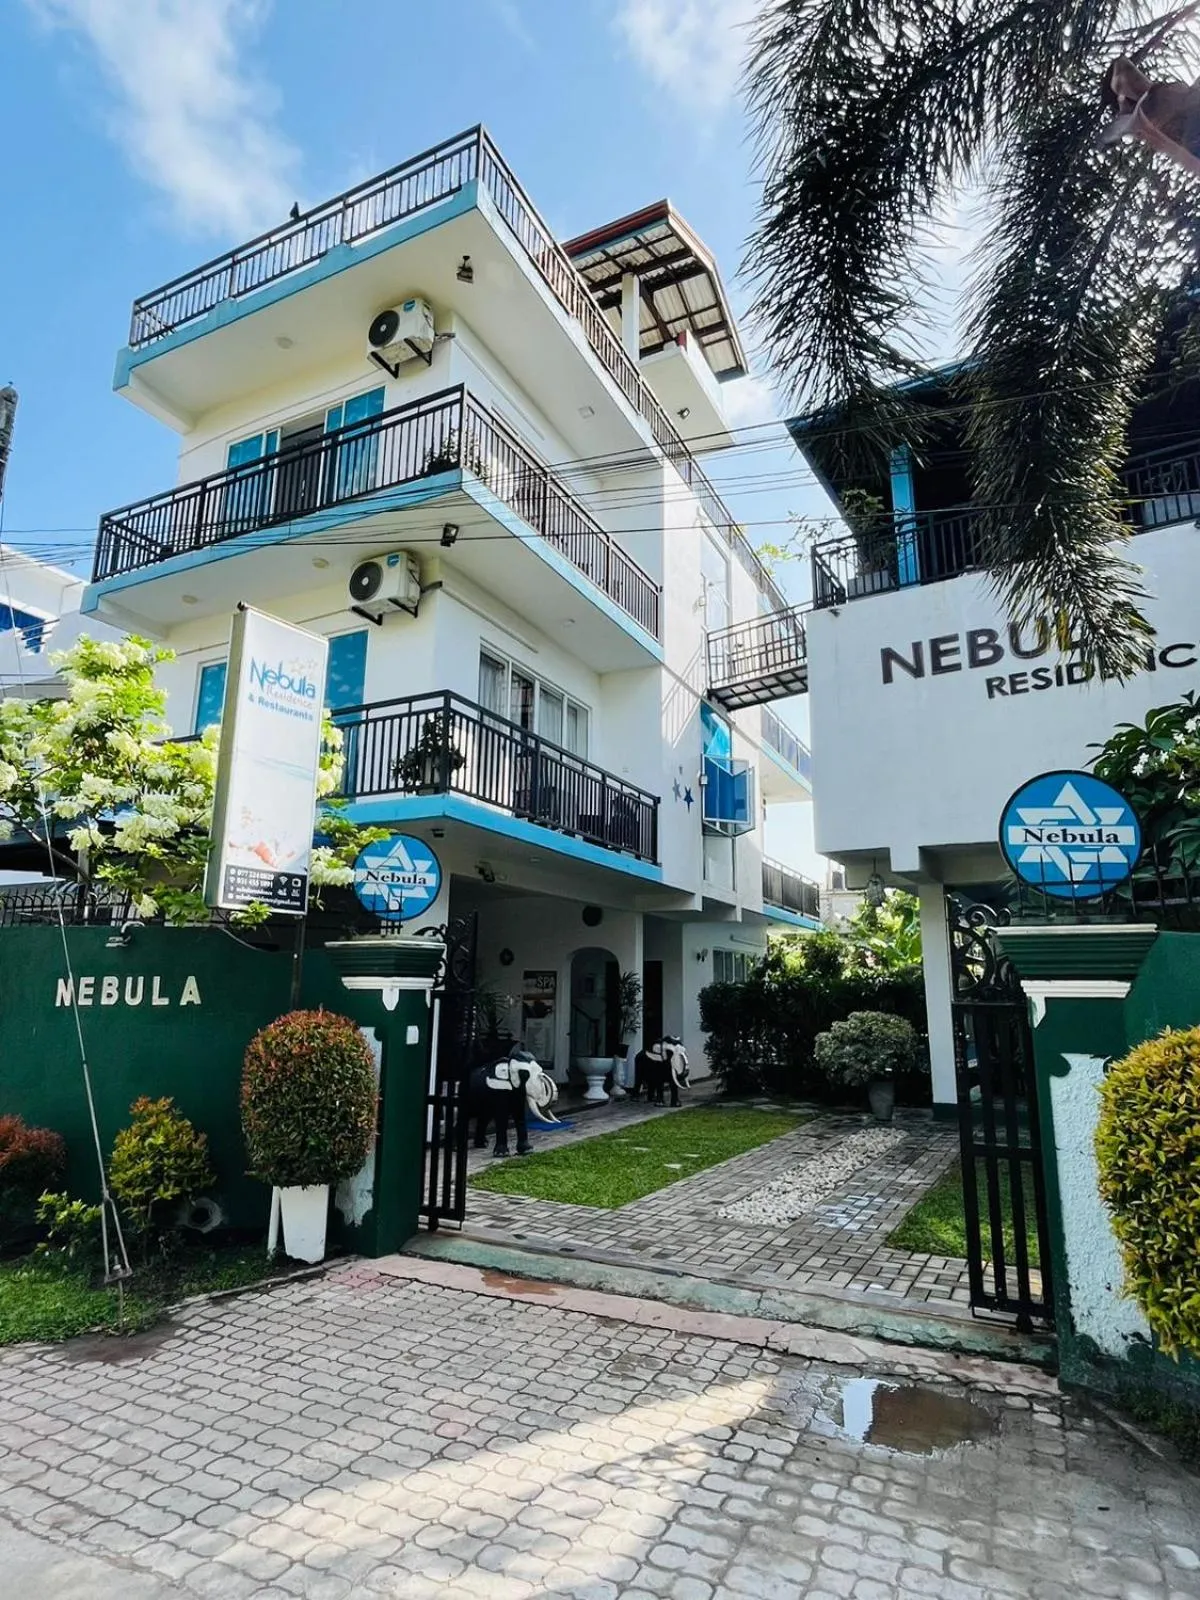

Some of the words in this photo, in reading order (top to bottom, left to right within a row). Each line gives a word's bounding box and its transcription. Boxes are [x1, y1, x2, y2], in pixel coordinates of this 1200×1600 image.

[880, 612, 1104, 685] NEBU
[249, 656, 316, 699] Nebula
[986, 643, 1197, 699] RESIDC
[248, 691, 255, 702] &
[258, 696, 313, 721] Restaurants
[1023, 828, 1120, 844] Nebula
[366, 870, 427, 885] Nebula
[55, 976, 202, 1007] NEBULA
[536, 976, 556, 988] SPA
